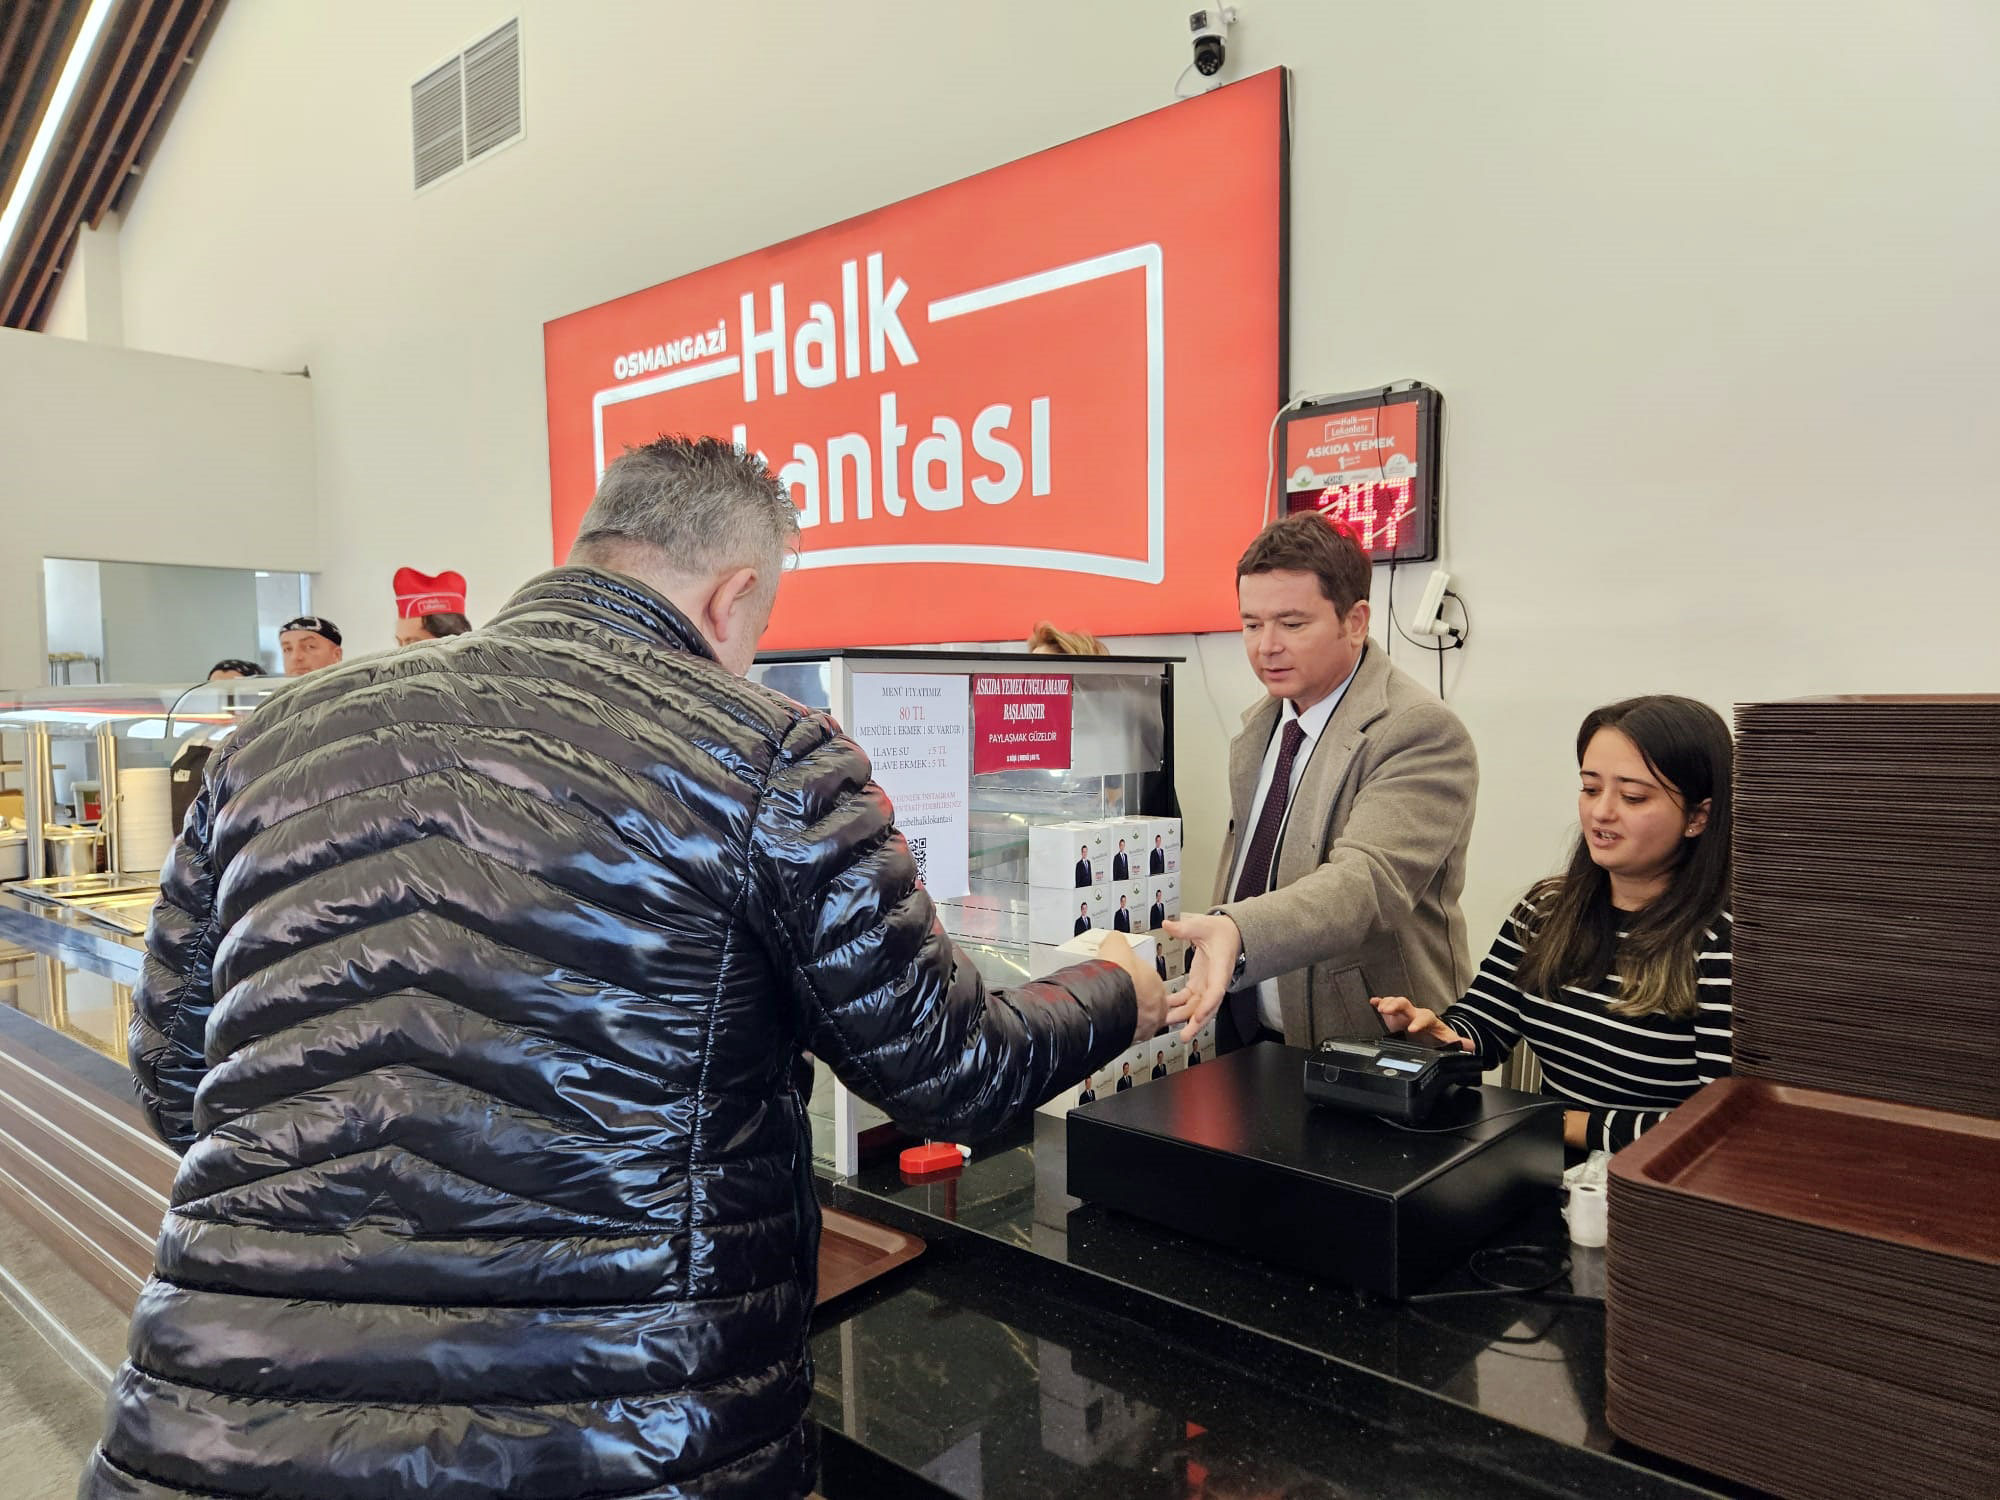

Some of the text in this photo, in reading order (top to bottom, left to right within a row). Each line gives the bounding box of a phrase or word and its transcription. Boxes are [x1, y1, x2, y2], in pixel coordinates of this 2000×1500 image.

[613, 251, 919, 402] OSMANGAZİ Halk
[1306, 436, 1395, 458] ASKIDA YEMEK
[733, 391, 1051, 529] antası
[1001, 679, 1024, 695] YEMEK
[899, 706, 926, 720] 80 TL
[1003, 703, 1045, 724] BAŞLAMIŞTIR
[988, 730, 1057, 744] PAYLAŞMAK GÜZELDİR
